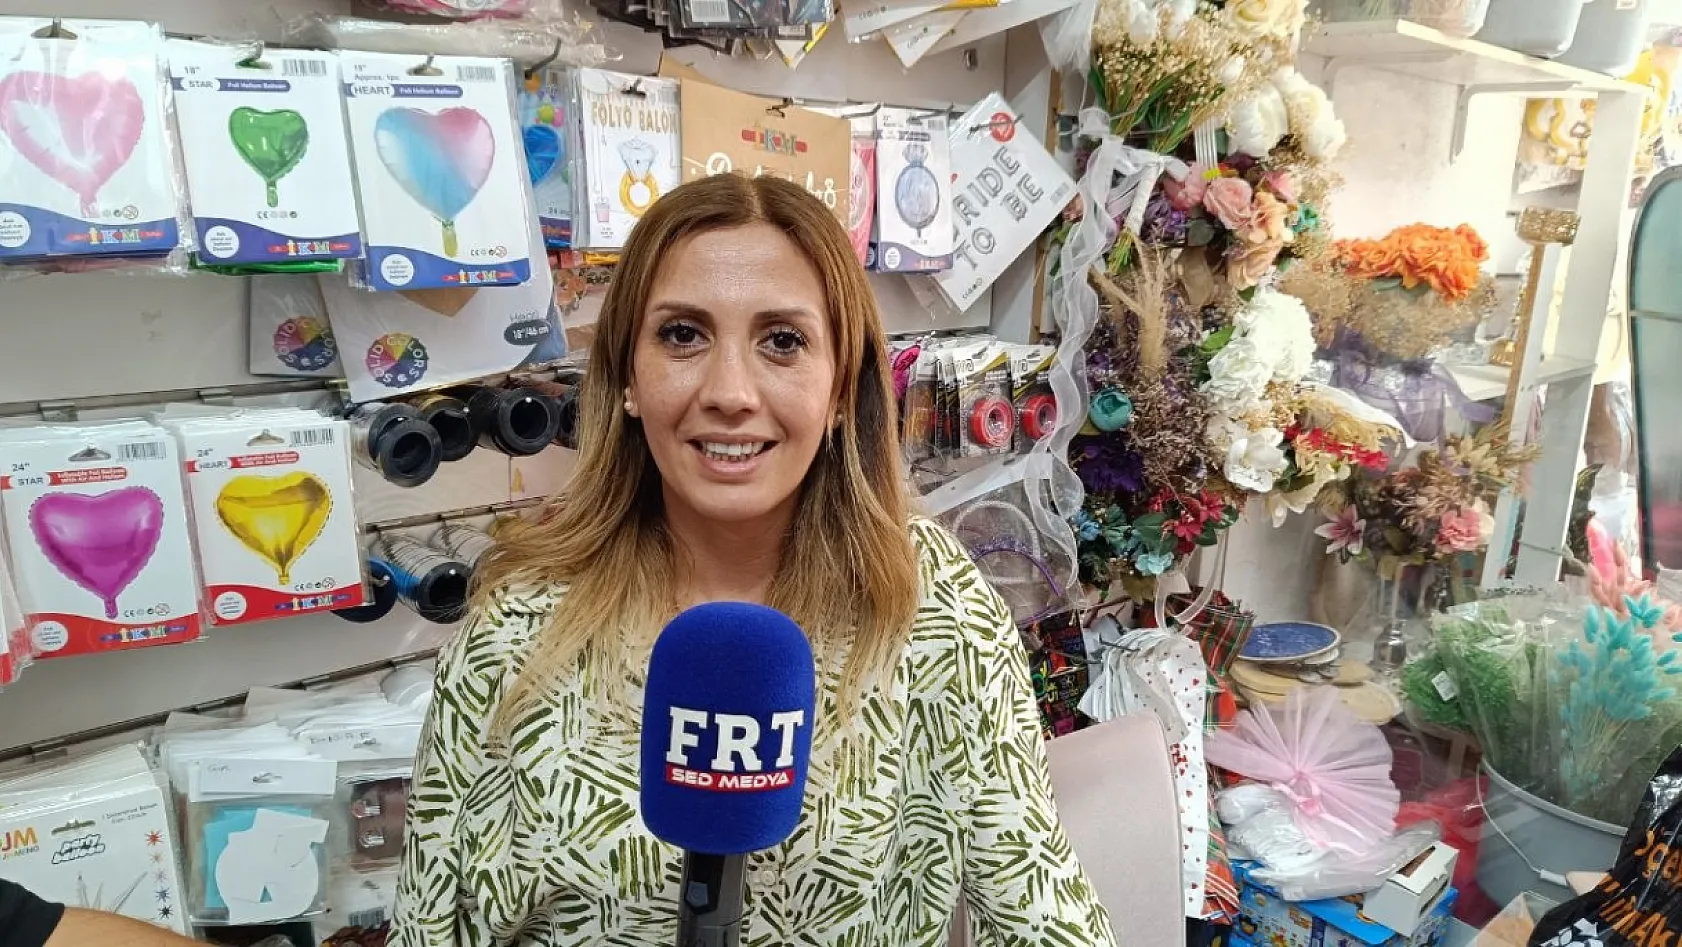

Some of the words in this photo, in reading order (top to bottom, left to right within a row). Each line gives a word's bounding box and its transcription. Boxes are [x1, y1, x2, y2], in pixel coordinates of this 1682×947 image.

[188, 80, 213, 88] STAR
[354, 86, 391, 95] HEART
[638, 108, 678, 135] BALON
[952, 145, 1021, 236] RIDE
[955, 227, 997, 271] TO
[1000, 173, 1045, 223] BE
[369, 344, 393, 383] SOLID
[386, 335, 424, 380] COLORS
[12, 462, 30, 472] 24"
[200, 461, 228, 469] HEART
[18, 477, 43, 486] STAR
[666, 706, 804, 771] FRT
[672, 768, 712, 785] SED
[717, 772, 790, 788] MEDYA
